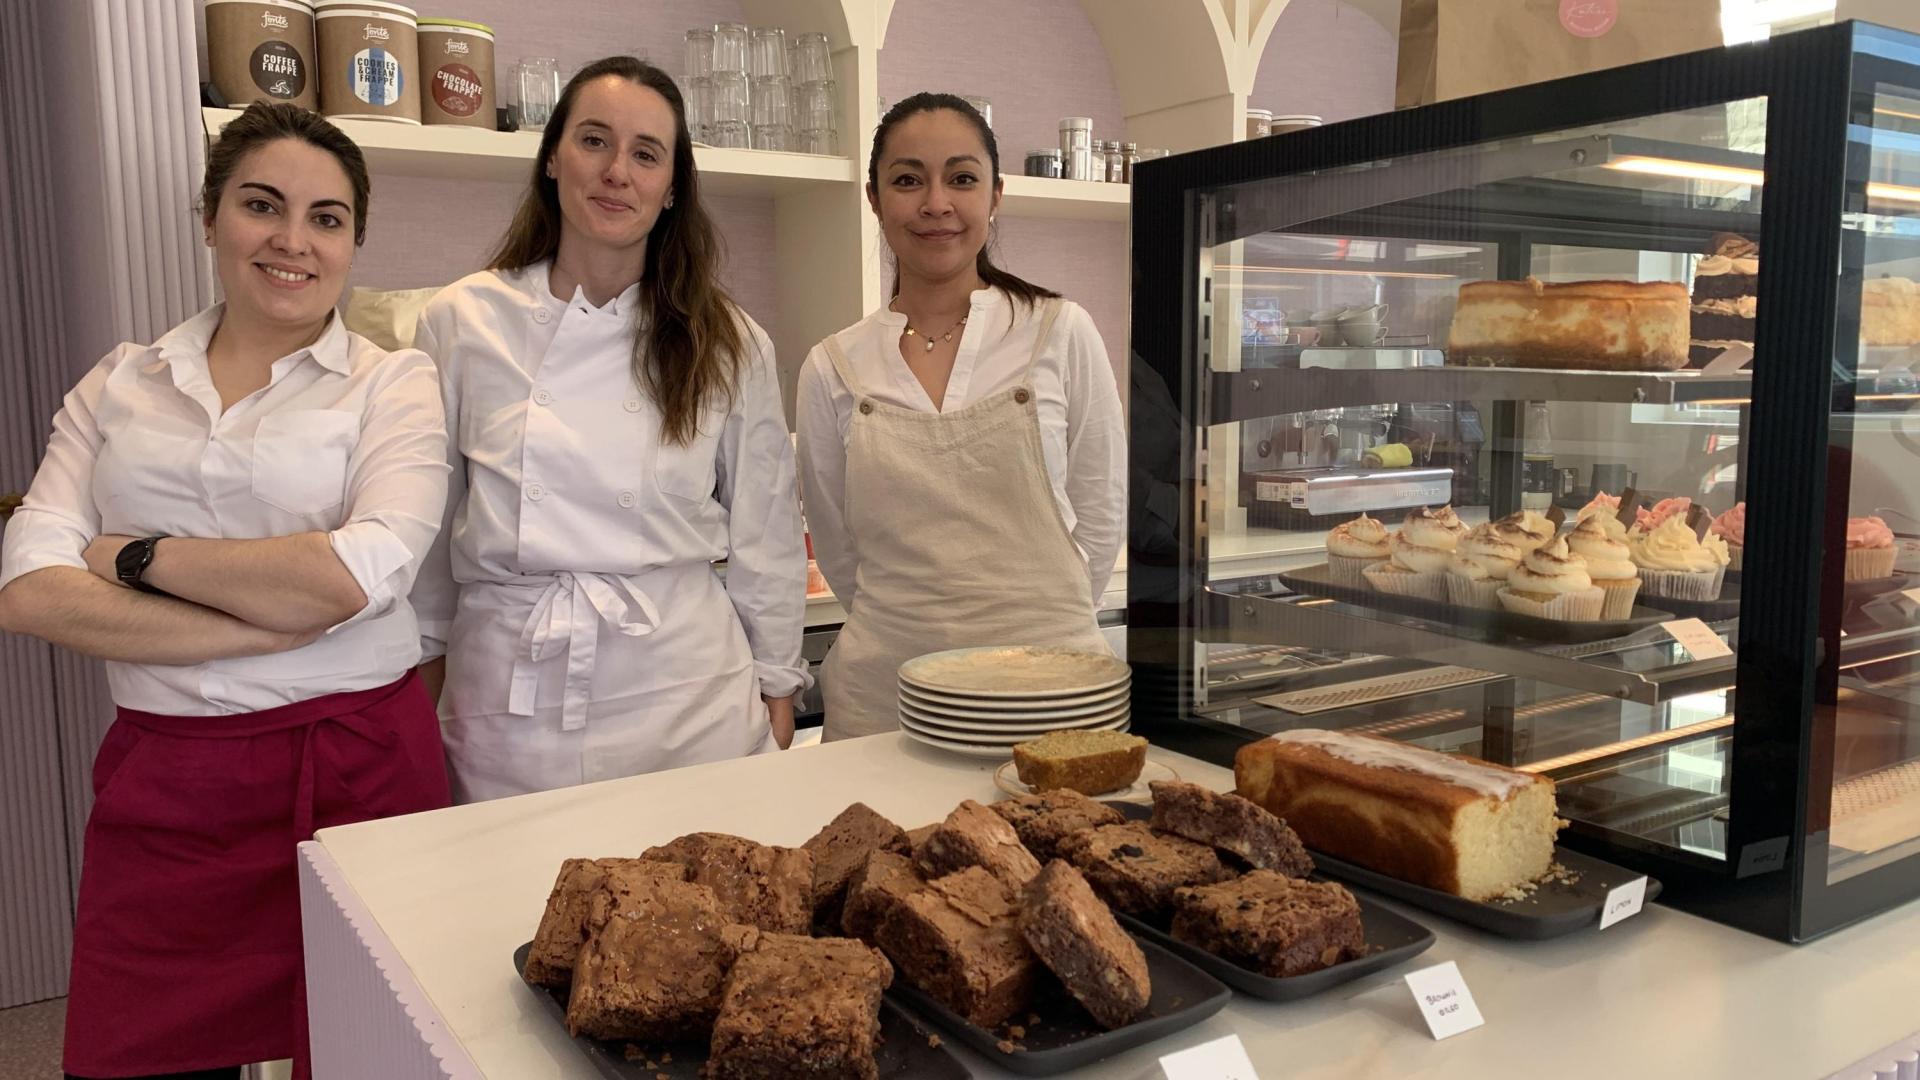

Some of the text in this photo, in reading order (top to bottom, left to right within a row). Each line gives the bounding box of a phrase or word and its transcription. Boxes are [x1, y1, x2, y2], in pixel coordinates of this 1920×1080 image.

[263, 54, 296, 68] COFFEE
[357, 58, 396, 71] COOKIES
[262, 62, 297, 76] FRAPPE
[360, 74, 393, 86] FRAPPE
[437, 70, 482, 95] CHOCOLATE
[443, 80, 474, 98] FRAPPE
